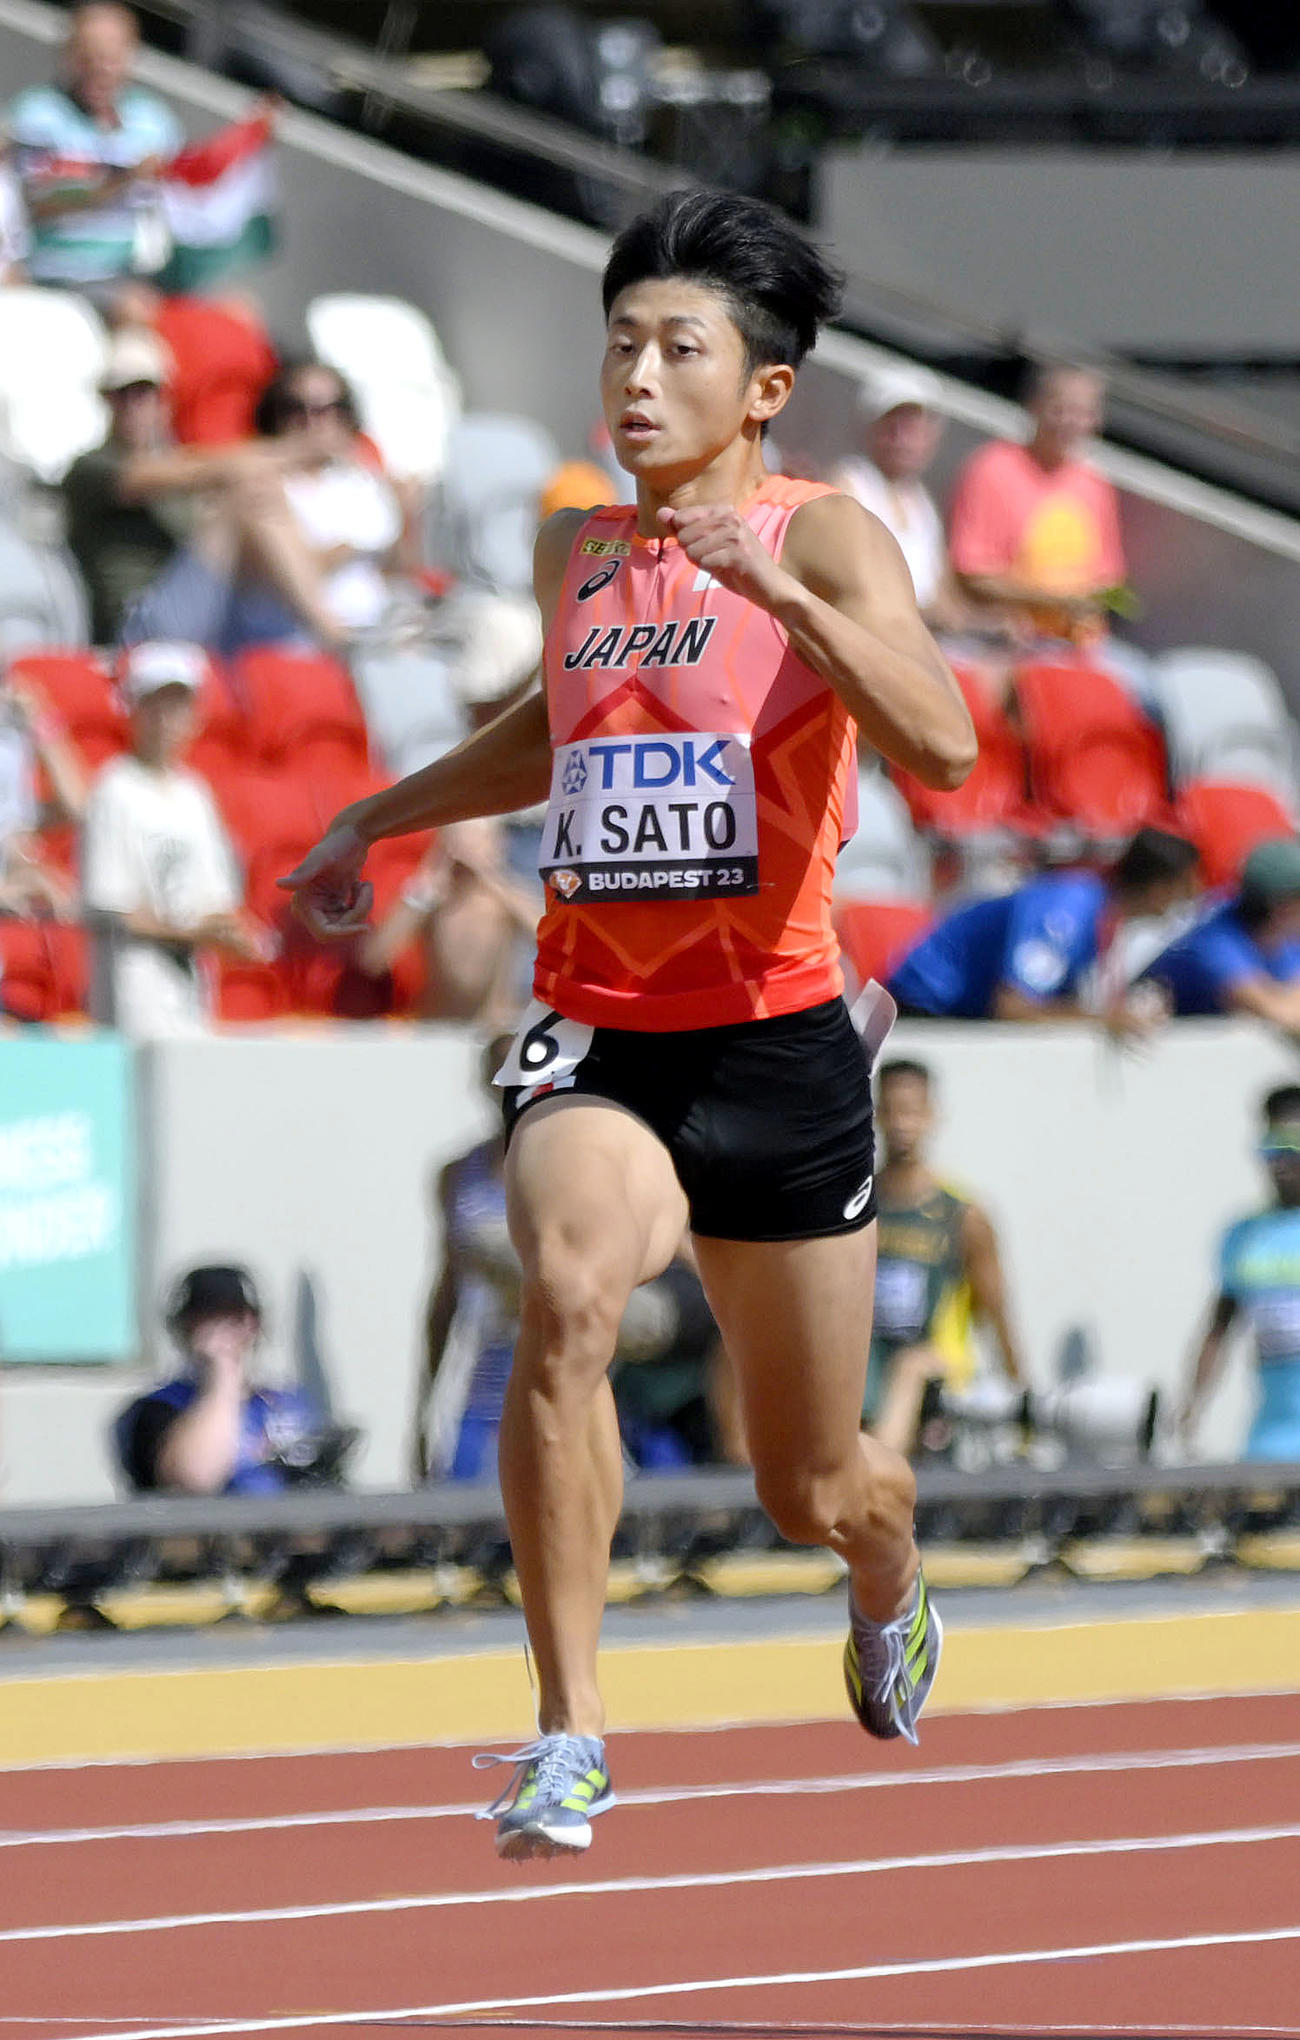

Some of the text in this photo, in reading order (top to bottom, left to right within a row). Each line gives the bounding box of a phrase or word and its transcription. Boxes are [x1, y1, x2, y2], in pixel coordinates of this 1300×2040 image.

[564, 617, 718, 671] JAPAN
[589, 740, 736, 789] TDK
[553, 802, 736, 859] K. SATO
[589, 868, 744, 890] BUDAPEST 23
[520, 1010, 565, 1072] 6
